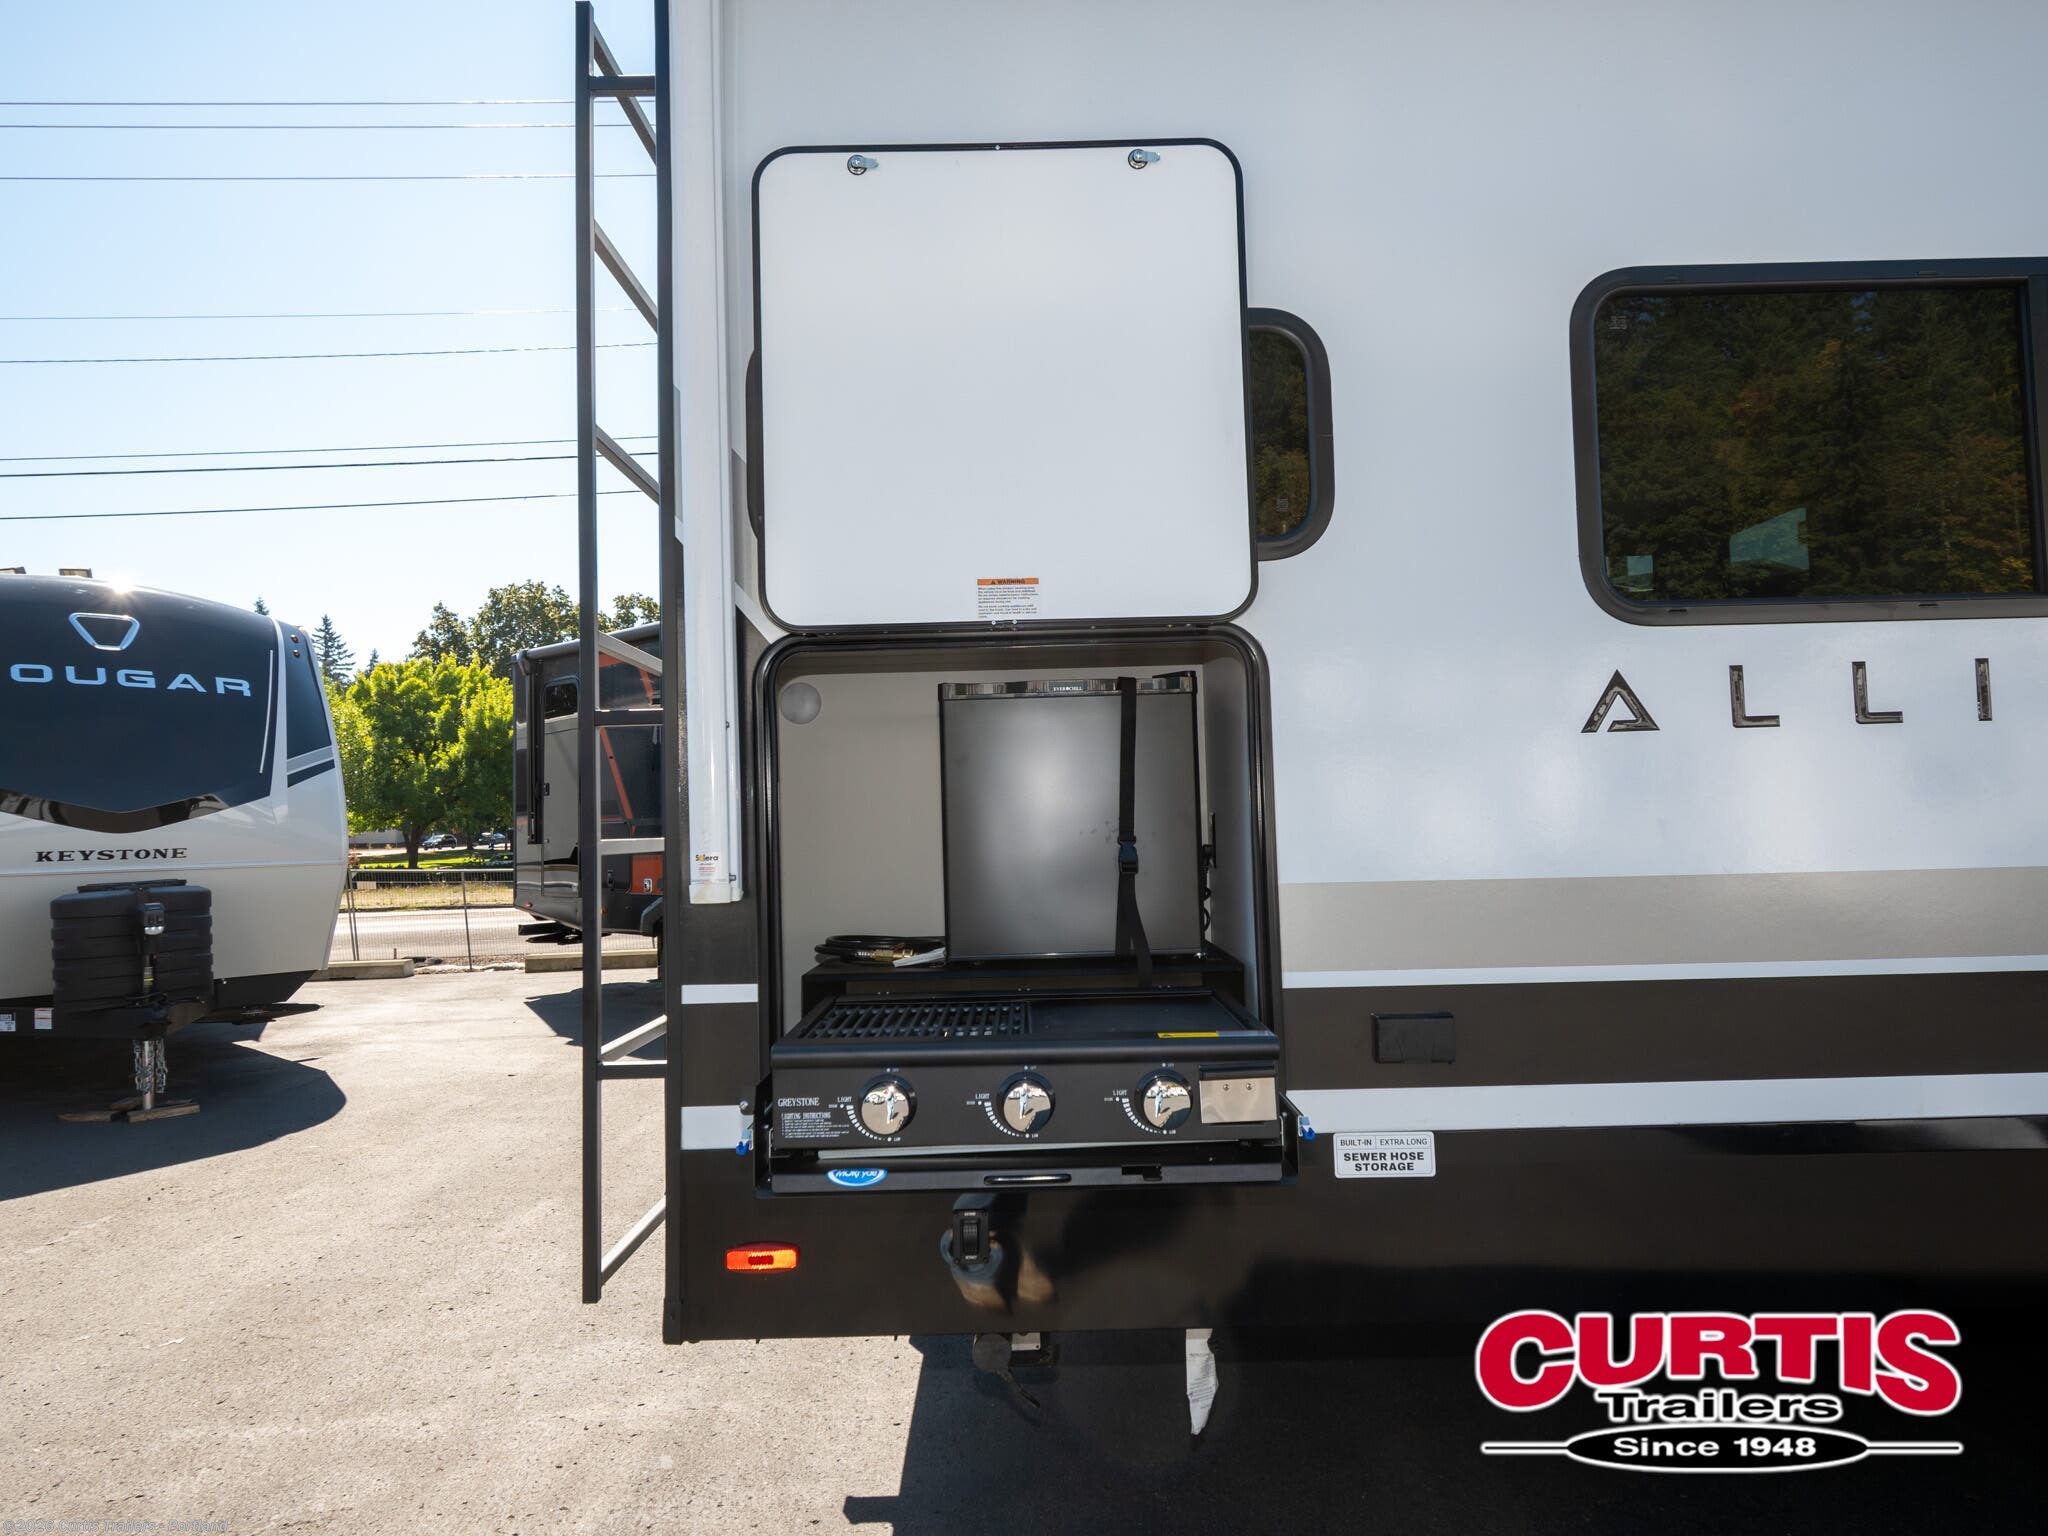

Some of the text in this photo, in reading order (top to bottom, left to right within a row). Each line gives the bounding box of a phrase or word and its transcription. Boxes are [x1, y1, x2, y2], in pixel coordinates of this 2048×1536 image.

[10, 663, 251, 697] OUGAR
[1580, 657, 1993, 734] ALLI
[35, 847, 188, 863] KEYSTONE
[777, 1097, 820, 1107] GREYSTONE
[1340, 1139, 1372, 1147] BUILT-IN
[1380, 1138, 1428, 1146] EXTRA LONG
[1343, 1151, 1425, 1162] SEWER HOSE
[1354, 1162, 1415, 1172] STORAGE
